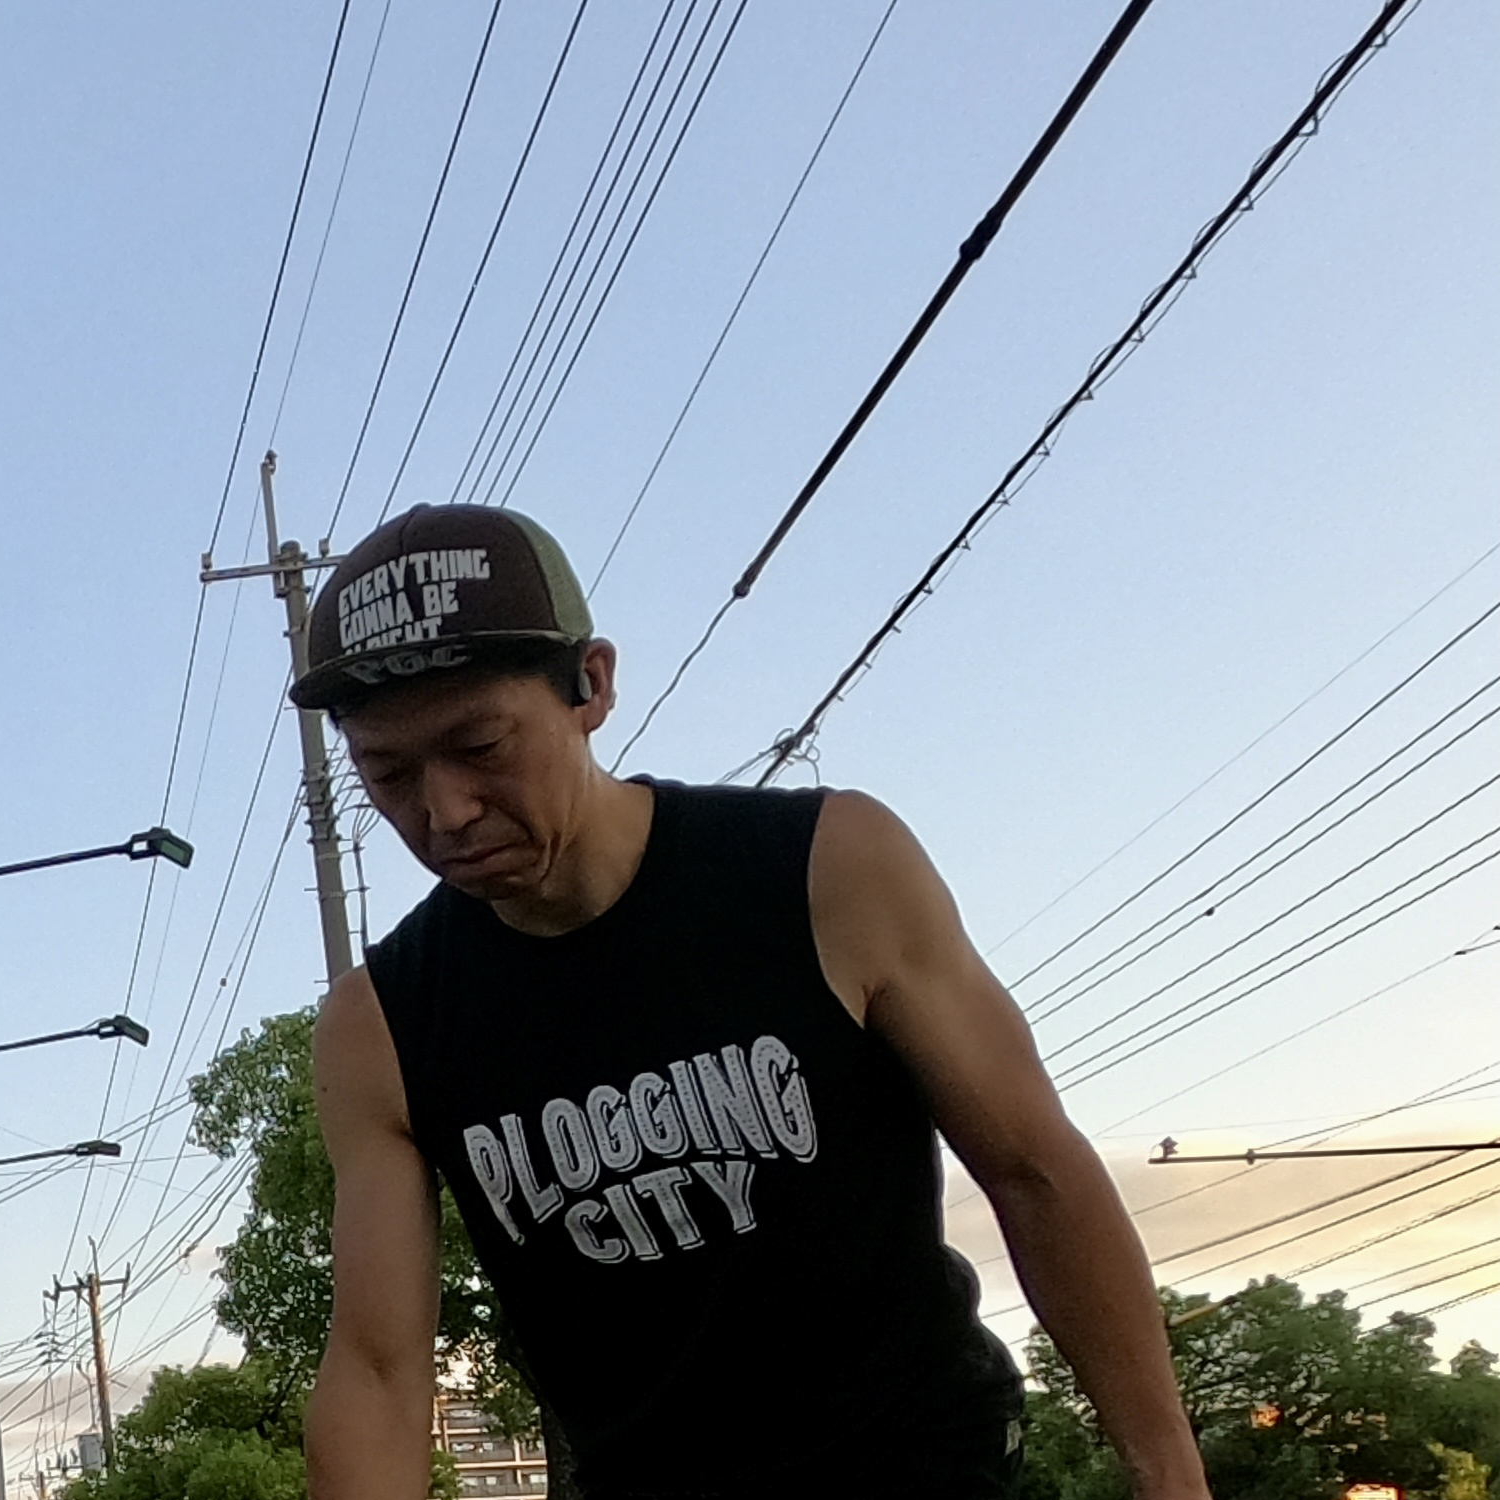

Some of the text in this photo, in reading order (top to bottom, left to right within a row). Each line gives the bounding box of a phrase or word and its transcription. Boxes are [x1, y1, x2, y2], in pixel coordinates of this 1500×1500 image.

[338, 549, 491, 619] EVERYTHING
[339, 581, 460, 649] GONNA BE
[463, 1035, 818, 1246] PLOGGING
[564, 1160, 757, 1264] CITY
